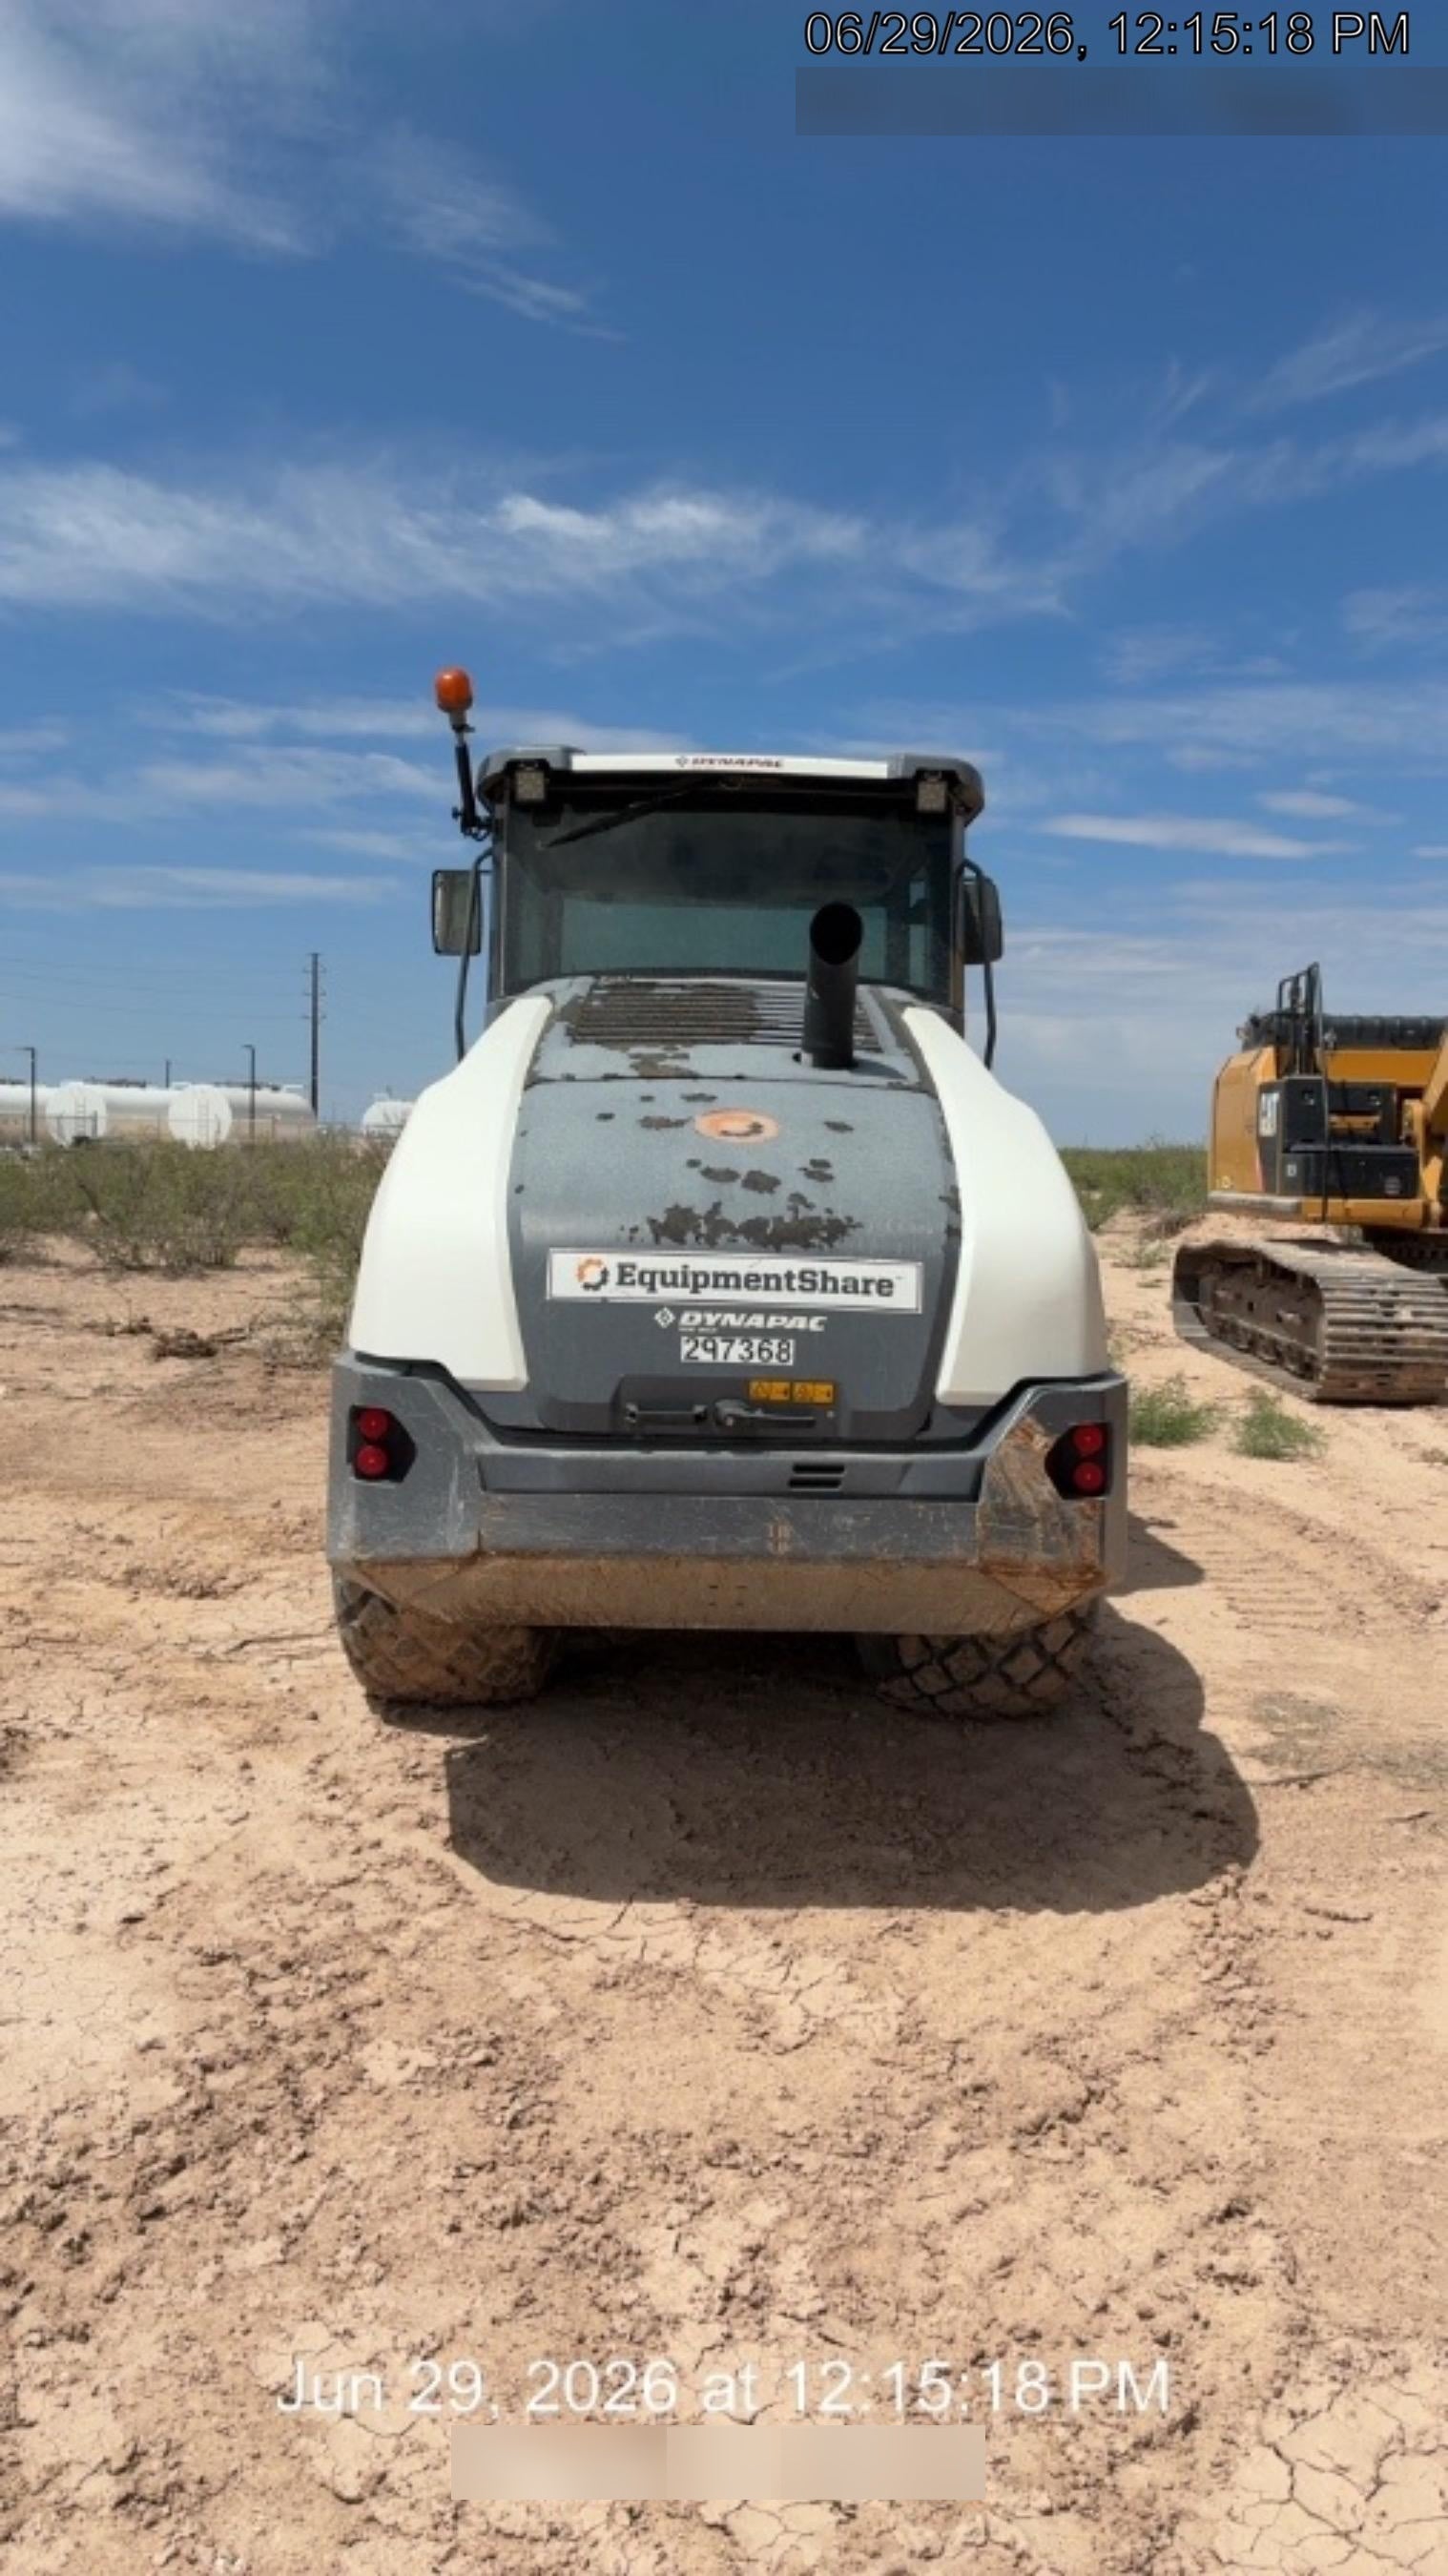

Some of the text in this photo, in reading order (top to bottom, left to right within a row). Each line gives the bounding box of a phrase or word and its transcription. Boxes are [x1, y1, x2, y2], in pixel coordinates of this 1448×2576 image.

[616, 1262, 894, 1298] EquipmentShare
[679, 1310, 828, 1332] DYNAPAC
[684, 1337, 791, 1363] 297368
